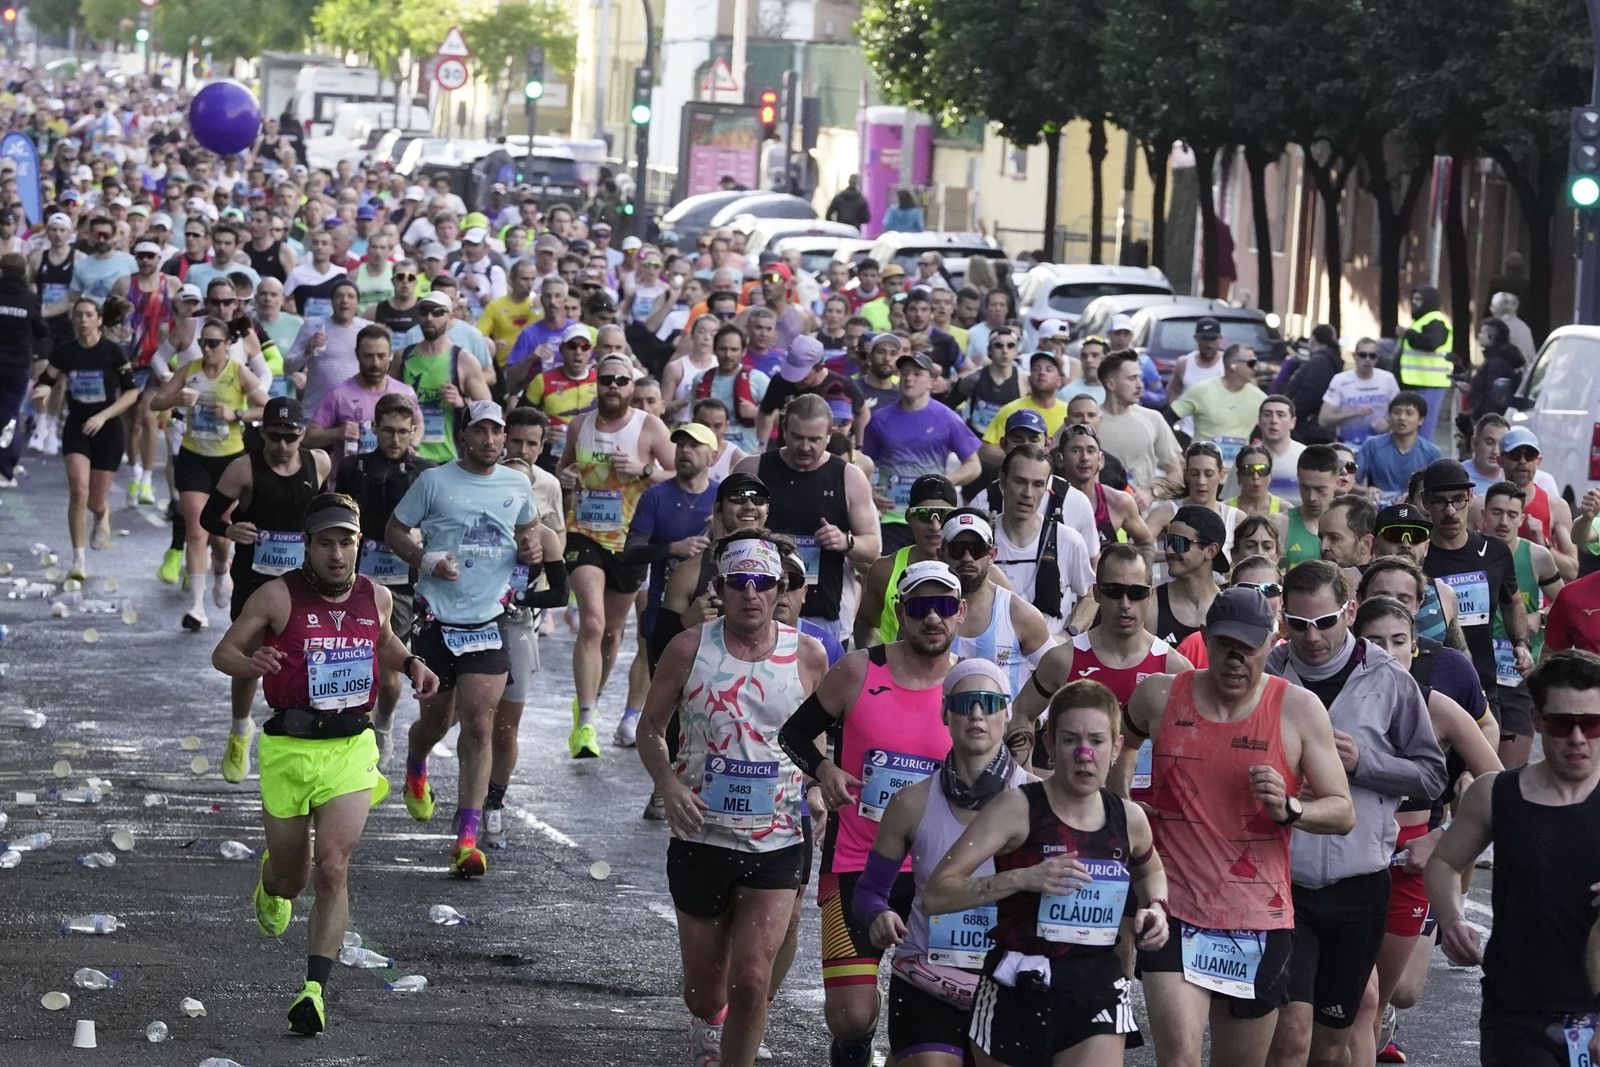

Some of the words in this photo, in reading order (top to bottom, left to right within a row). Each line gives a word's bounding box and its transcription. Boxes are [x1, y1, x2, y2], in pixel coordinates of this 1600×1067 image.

[443, 68, 463, 80] 30
[582, 512, 617, 521] NIKOLAJ
[273, 533, 303, 541] ZURICH
[260, 551, 298, 566] ÁLVARO
[374, 565, 395, 575] MAX
[1447, 574, 1480, 585] ZURICH
[447, 638, 460, 647] EL
[330, 649, 366, 660] ZURICH
[332, 668, 351, 678] 6717
[312, 682, 338, 697] LUIS
[341, 675, 370, 693] JOSÉ
[730, 764, 772, 775] ZURICH
[892, 757, 935, 771] ZURICH
[728, 783, 752, 795] 5483
[723, 796, 753, 812] MEL
[1086, 863, 1121, 876] URICH
[1075, 888, 1100, 901] 7014
[1049, 901, 1114, 924] CLÀUDIA
[962, 914, 990, 926] 6883
[1211, 942, 1236, 955] 7354
[1191, 953, 1248, 979] JUANMA
